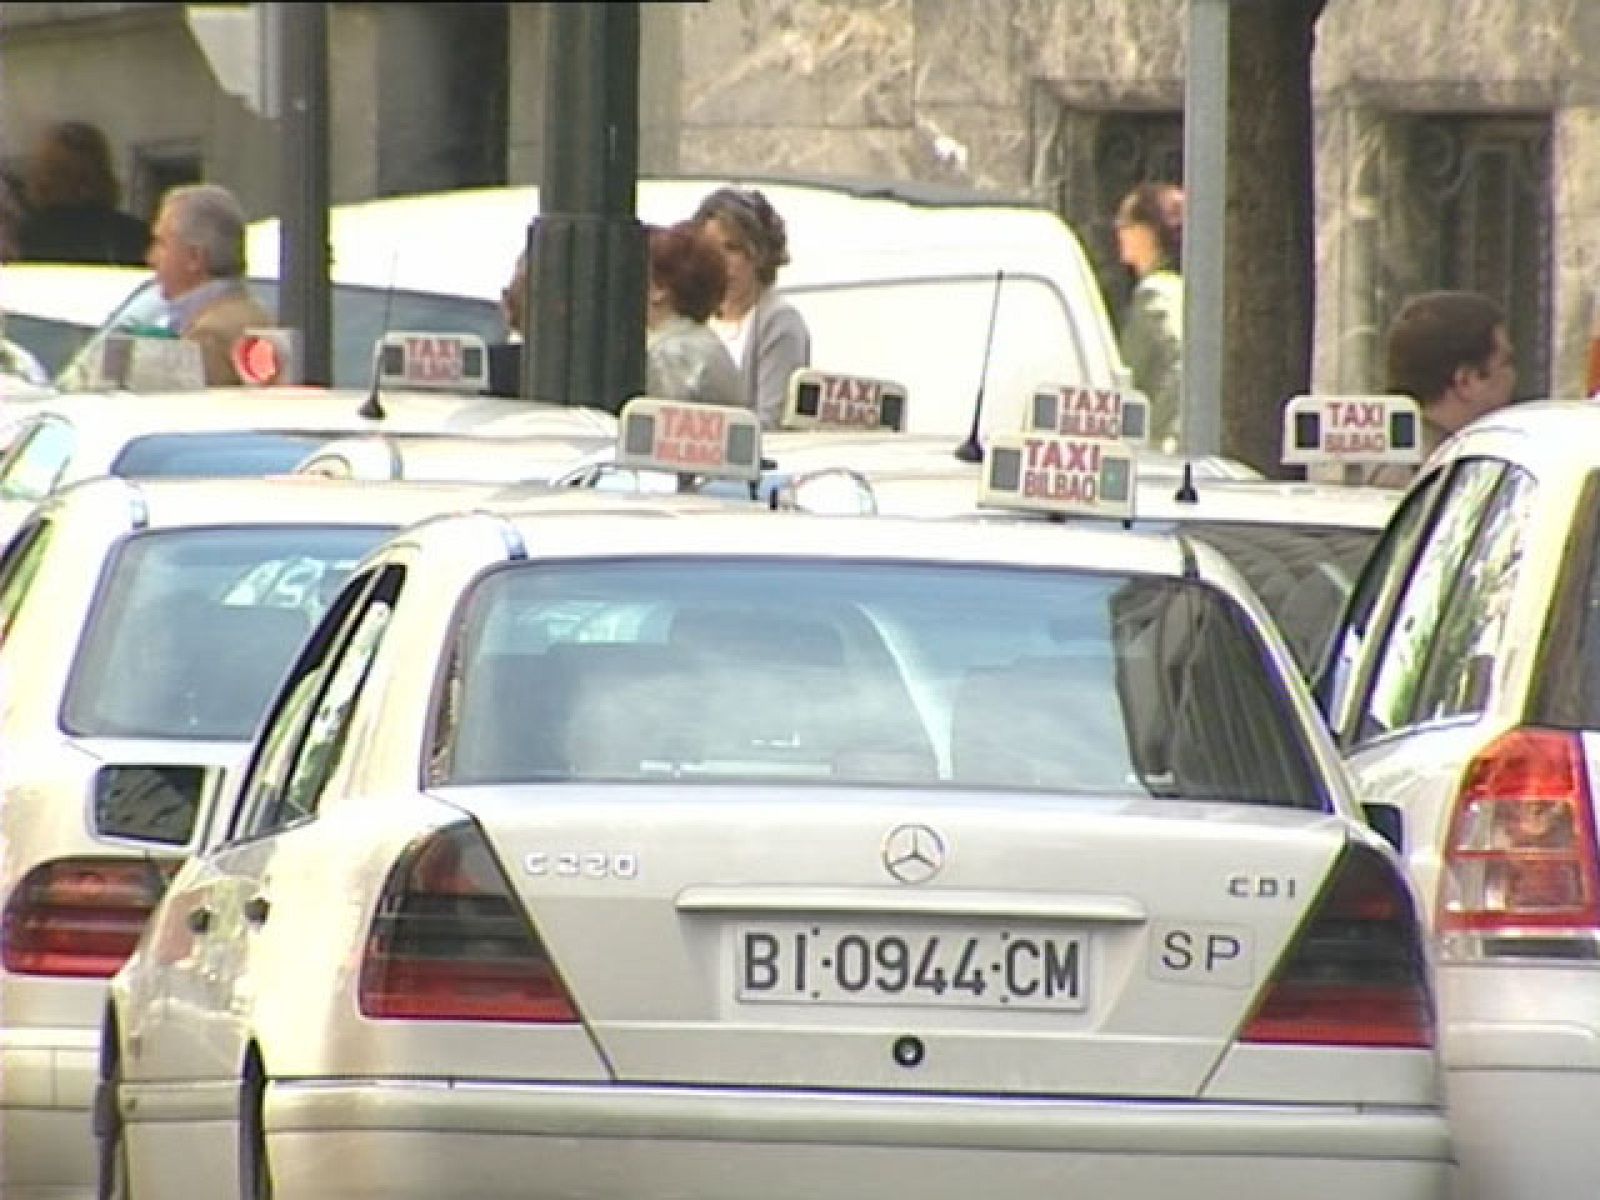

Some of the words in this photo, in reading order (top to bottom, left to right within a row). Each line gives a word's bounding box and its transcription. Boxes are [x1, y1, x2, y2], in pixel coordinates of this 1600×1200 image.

[406, 338, 461, 361] TAXI
[822, 376, 881, 402] TAXI
[1059, 386, 1121, 413] TAXI
[660, 407, 722, 441] TAXI
[1058, 412, 1120, 438] BILBAO
[1328, 402, 1385, 428] TAXI
[1024, 440, 1100, 473] TAXI
[1023, 472, 1097, 504] BILBAO
[1229, 877, 1296, 898] CDI
